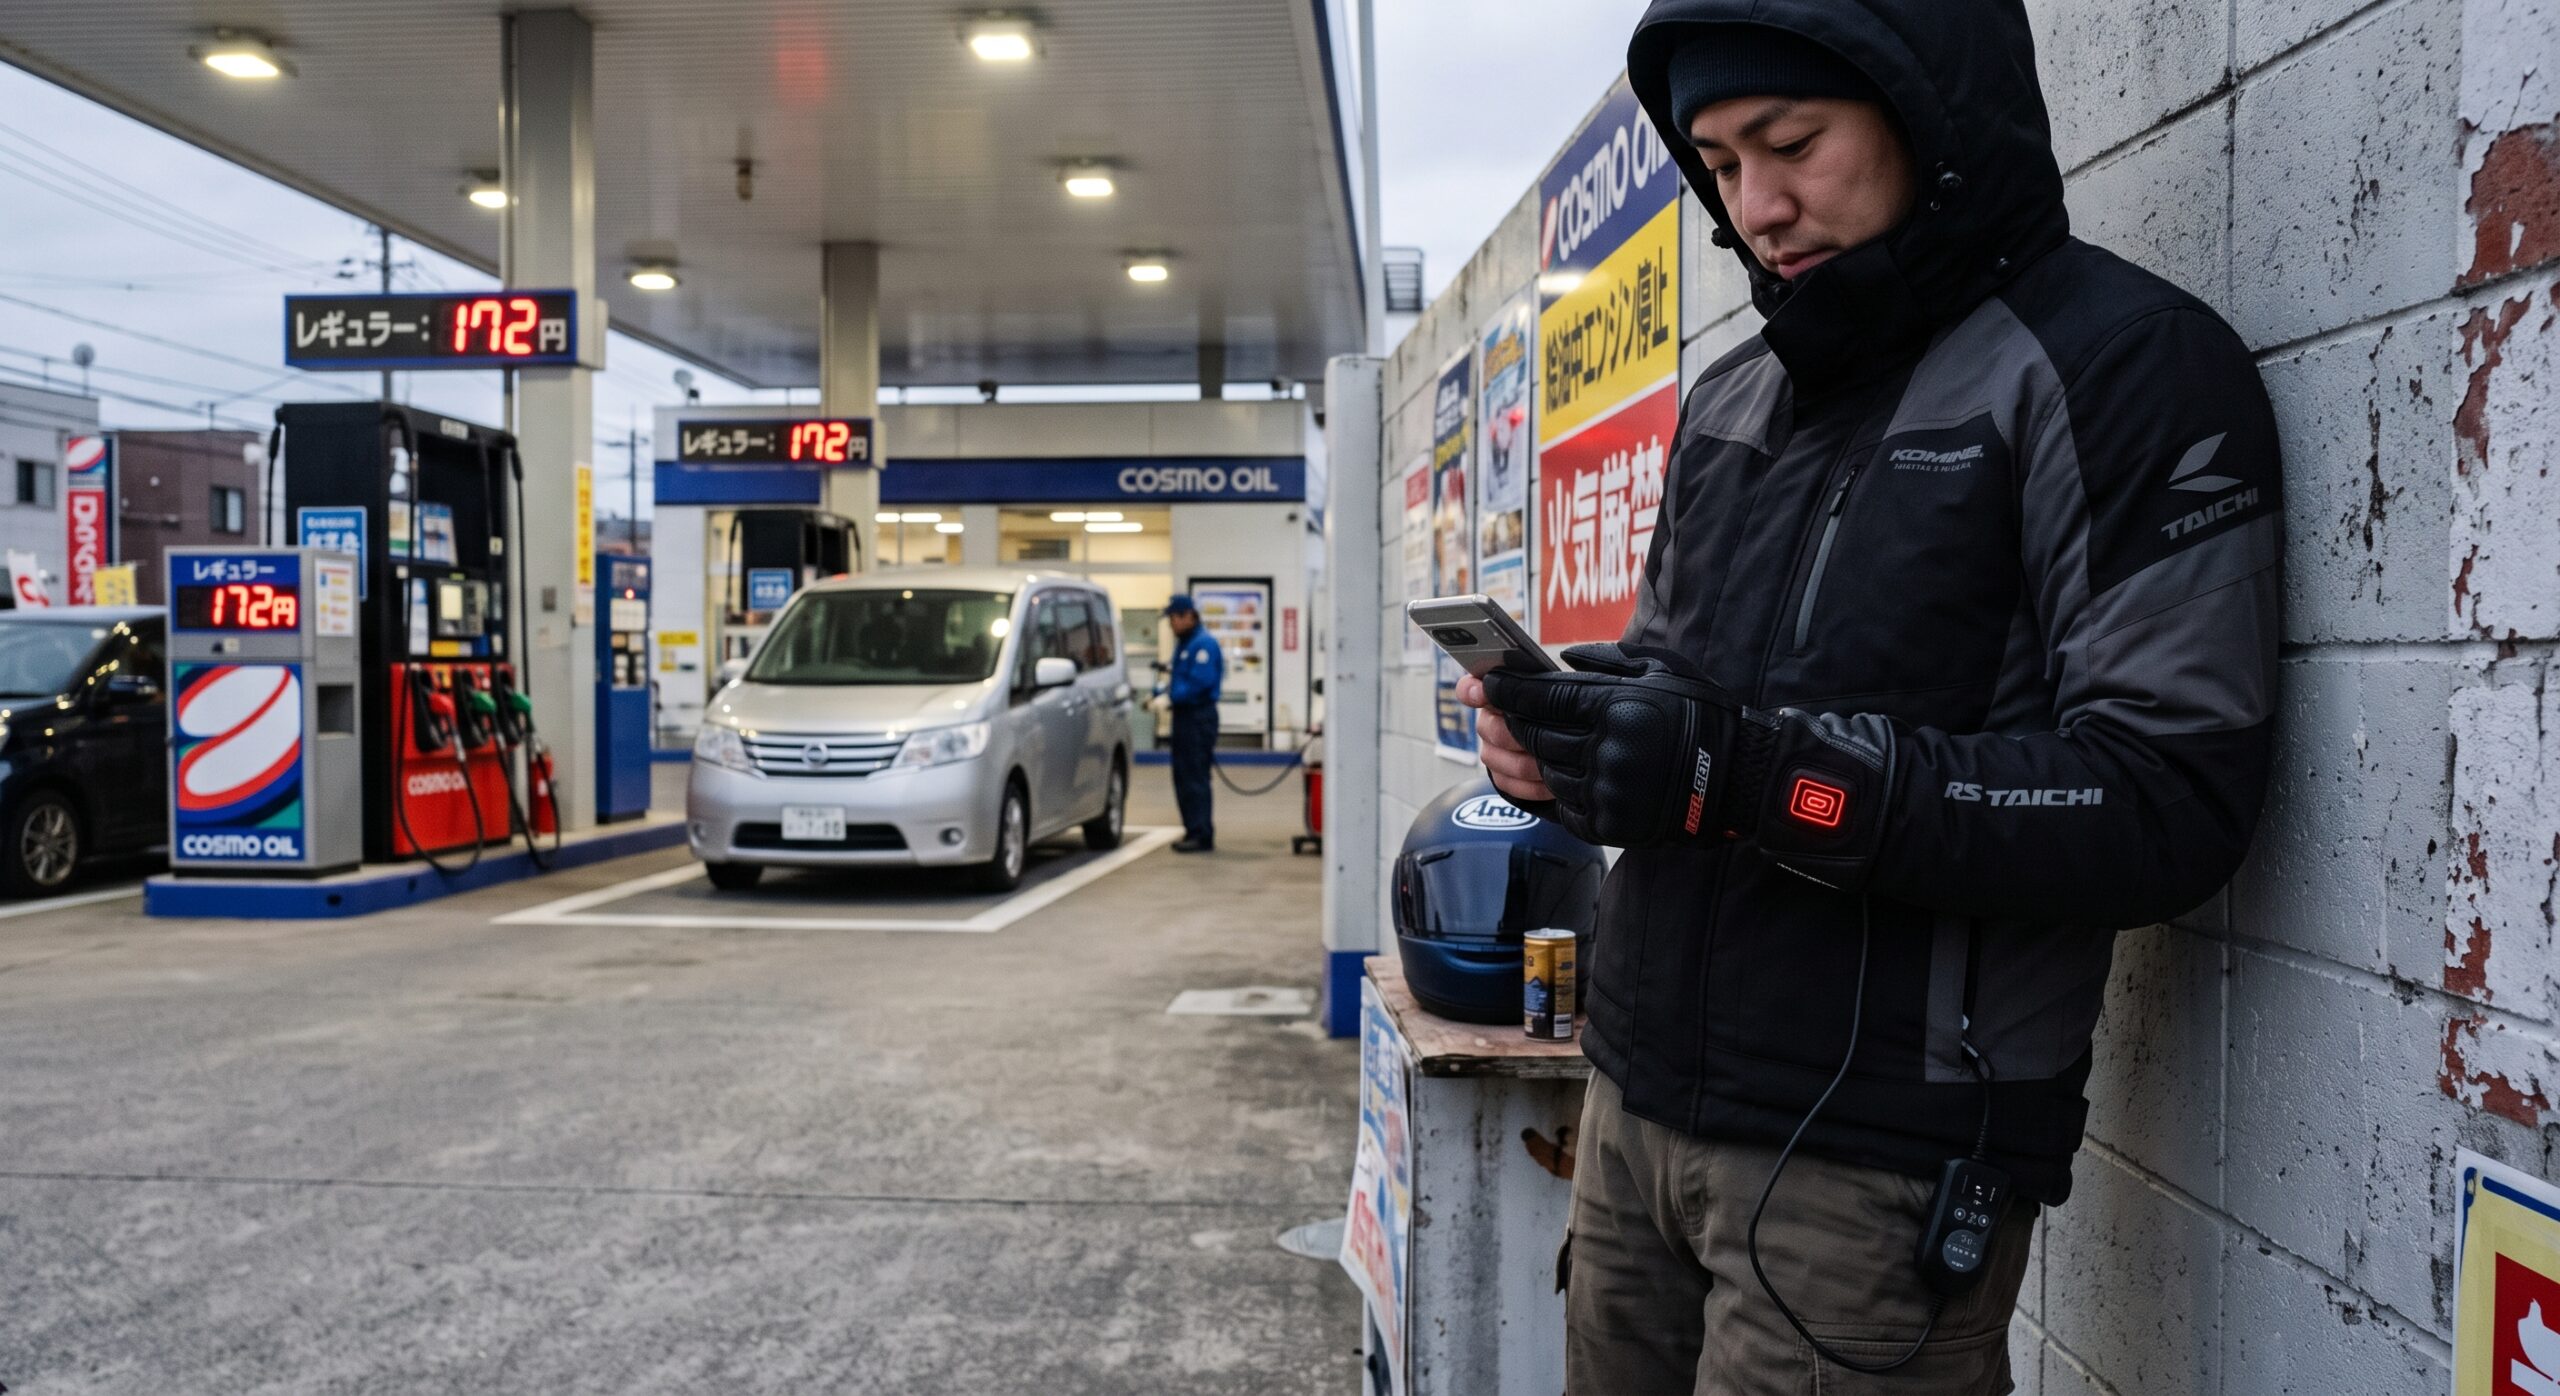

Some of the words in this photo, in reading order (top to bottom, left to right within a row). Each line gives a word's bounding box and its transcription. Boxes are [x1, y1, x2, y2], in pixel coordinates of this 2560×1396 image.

[1558, 124, 1630, 261] COSMO
[1546, 246, 1669, 415] 給油中エンジン停止
[1889, 444, 1984, 463] KOMINE
[1118, 467, 1227, 493] COSMO
[1231, 467, 1279, 493] OIL
[2161, 487, 2259, 540] TAICHI
[193, 559, 276, 581] レギュラー
[1943, 781, 1983, 802] RS
[1985, 788, 2104, 807] TAICHI
[182, 834, 261, 857] COSMO
[263, 835, 299, 857] OIL
